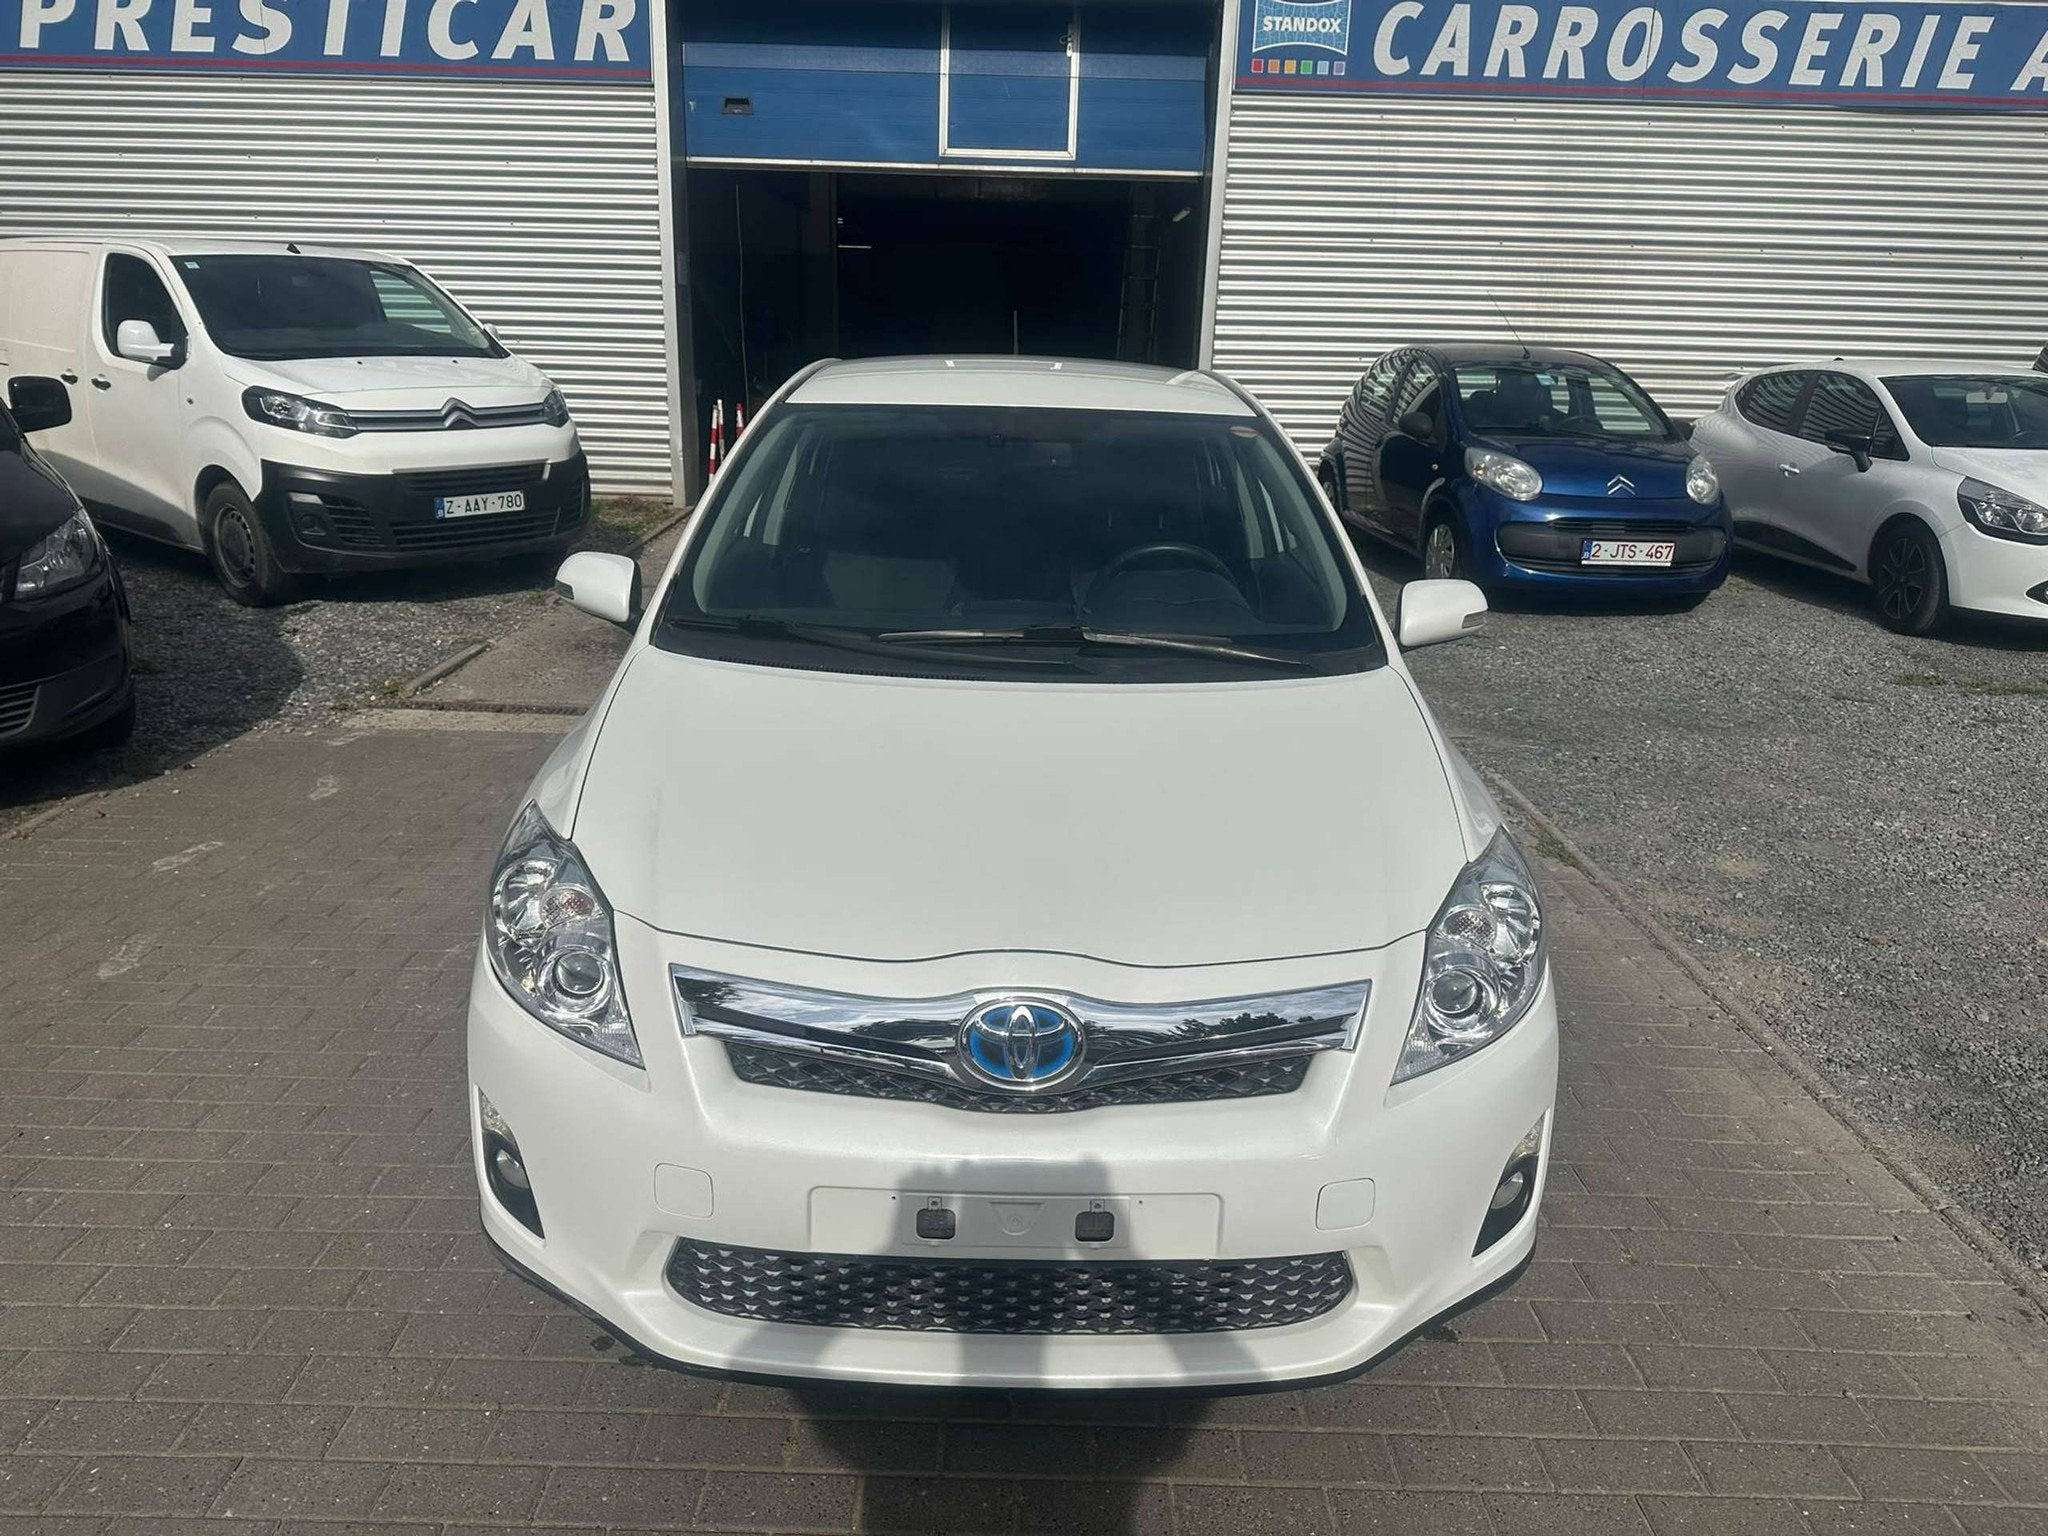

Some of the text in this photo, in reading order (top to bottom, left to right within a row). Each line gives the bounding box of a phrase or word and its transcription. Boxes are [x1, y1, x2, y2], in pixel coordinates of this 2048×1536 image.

[1263, 15, 1342, 33] STANDOX
[1374, 2, 1994, 90] CARROSSERIE
[446, 494, 522, 514] Z-AAY-780
[1591, 543, 1673, 560] 2-JTS-467
